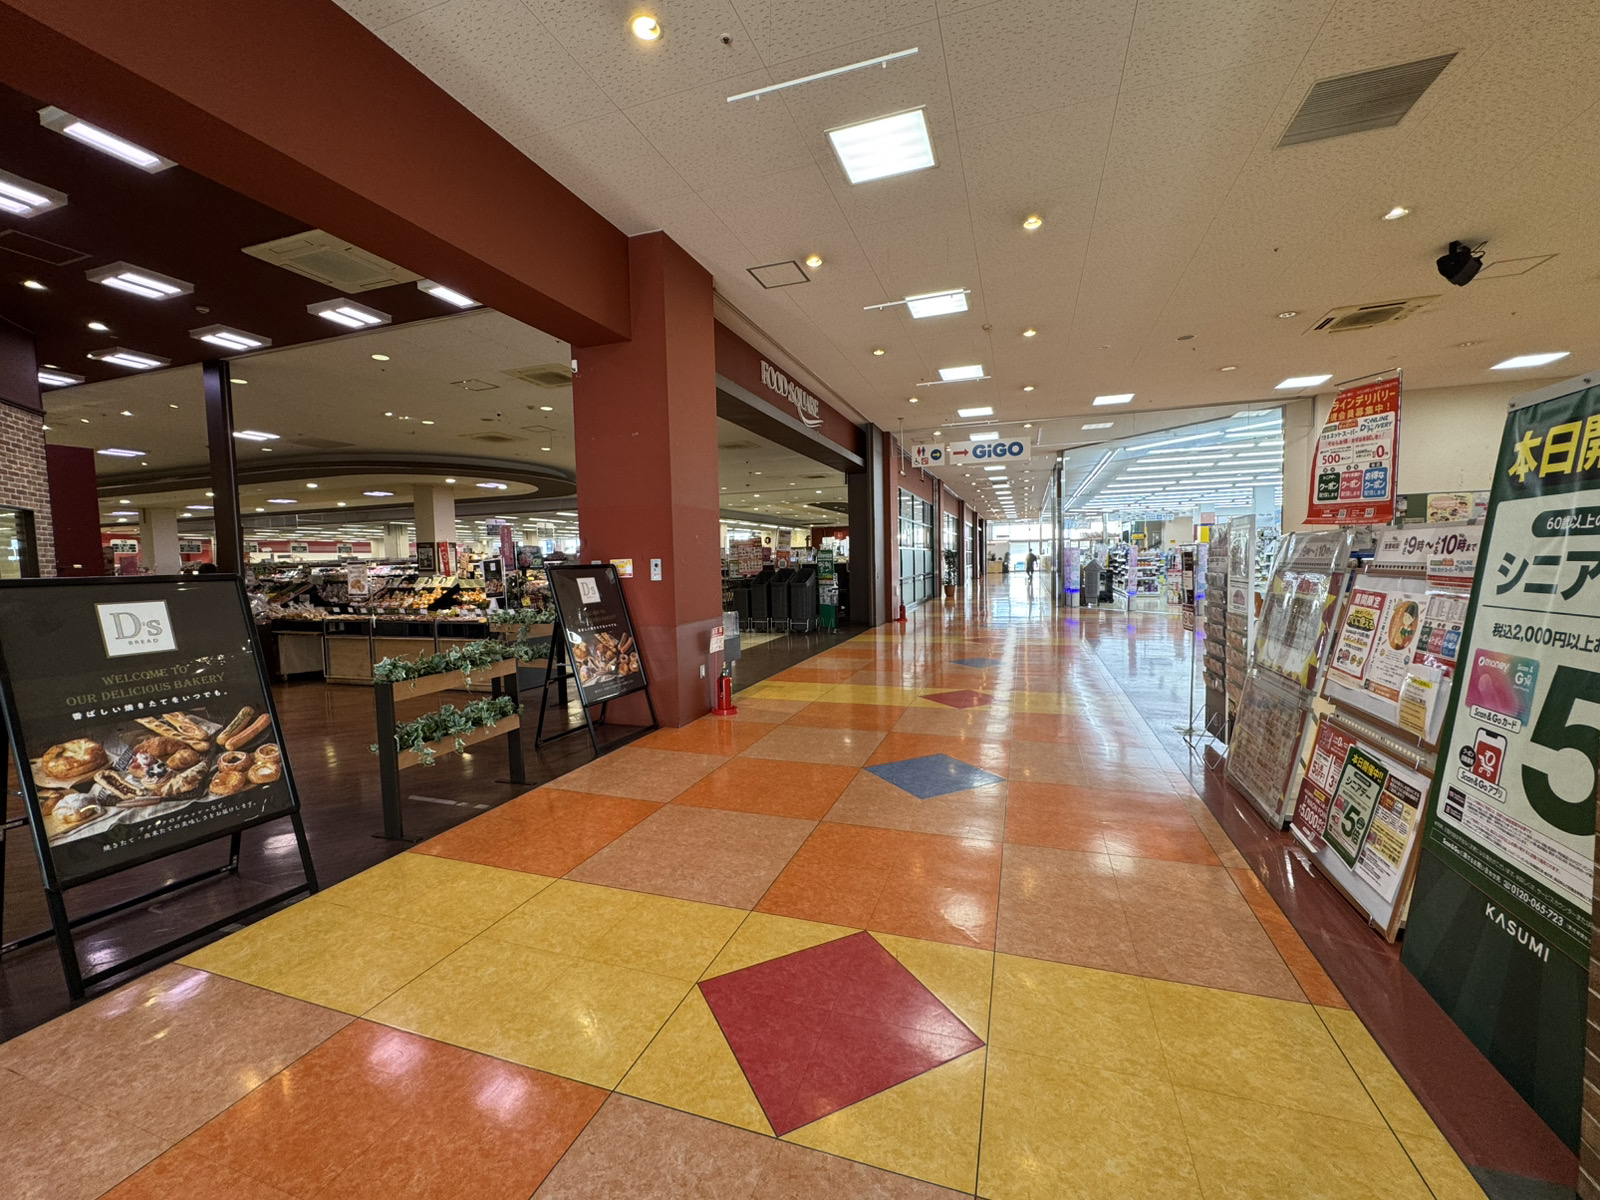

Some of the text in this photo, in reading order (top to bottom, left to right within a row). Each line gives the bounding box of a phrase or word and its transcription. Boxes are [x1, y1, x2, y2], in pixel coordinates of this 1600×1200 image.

[761, 360, 820, 421] FOOD SQUARE
[972, 441, 1024, 459] GiGO
[1322, 453, 1340, 465] 500
[1496, 551, 1600, 601] シニア
[109, 611, 163, 640] D's
[128, 637, 159, 646] BREAD
[66, 672, 225, 706] OUR DELICIOUS BAKERY
[102, 664, 188, 686] WELCOME TO
[1521, 664, 1600, 837] 5
[1341, 804, 1362, 838] 5
[1511, 883, 1564, 927] 0120-065-723
[1485, 902, 1550, 963] KASUMI
